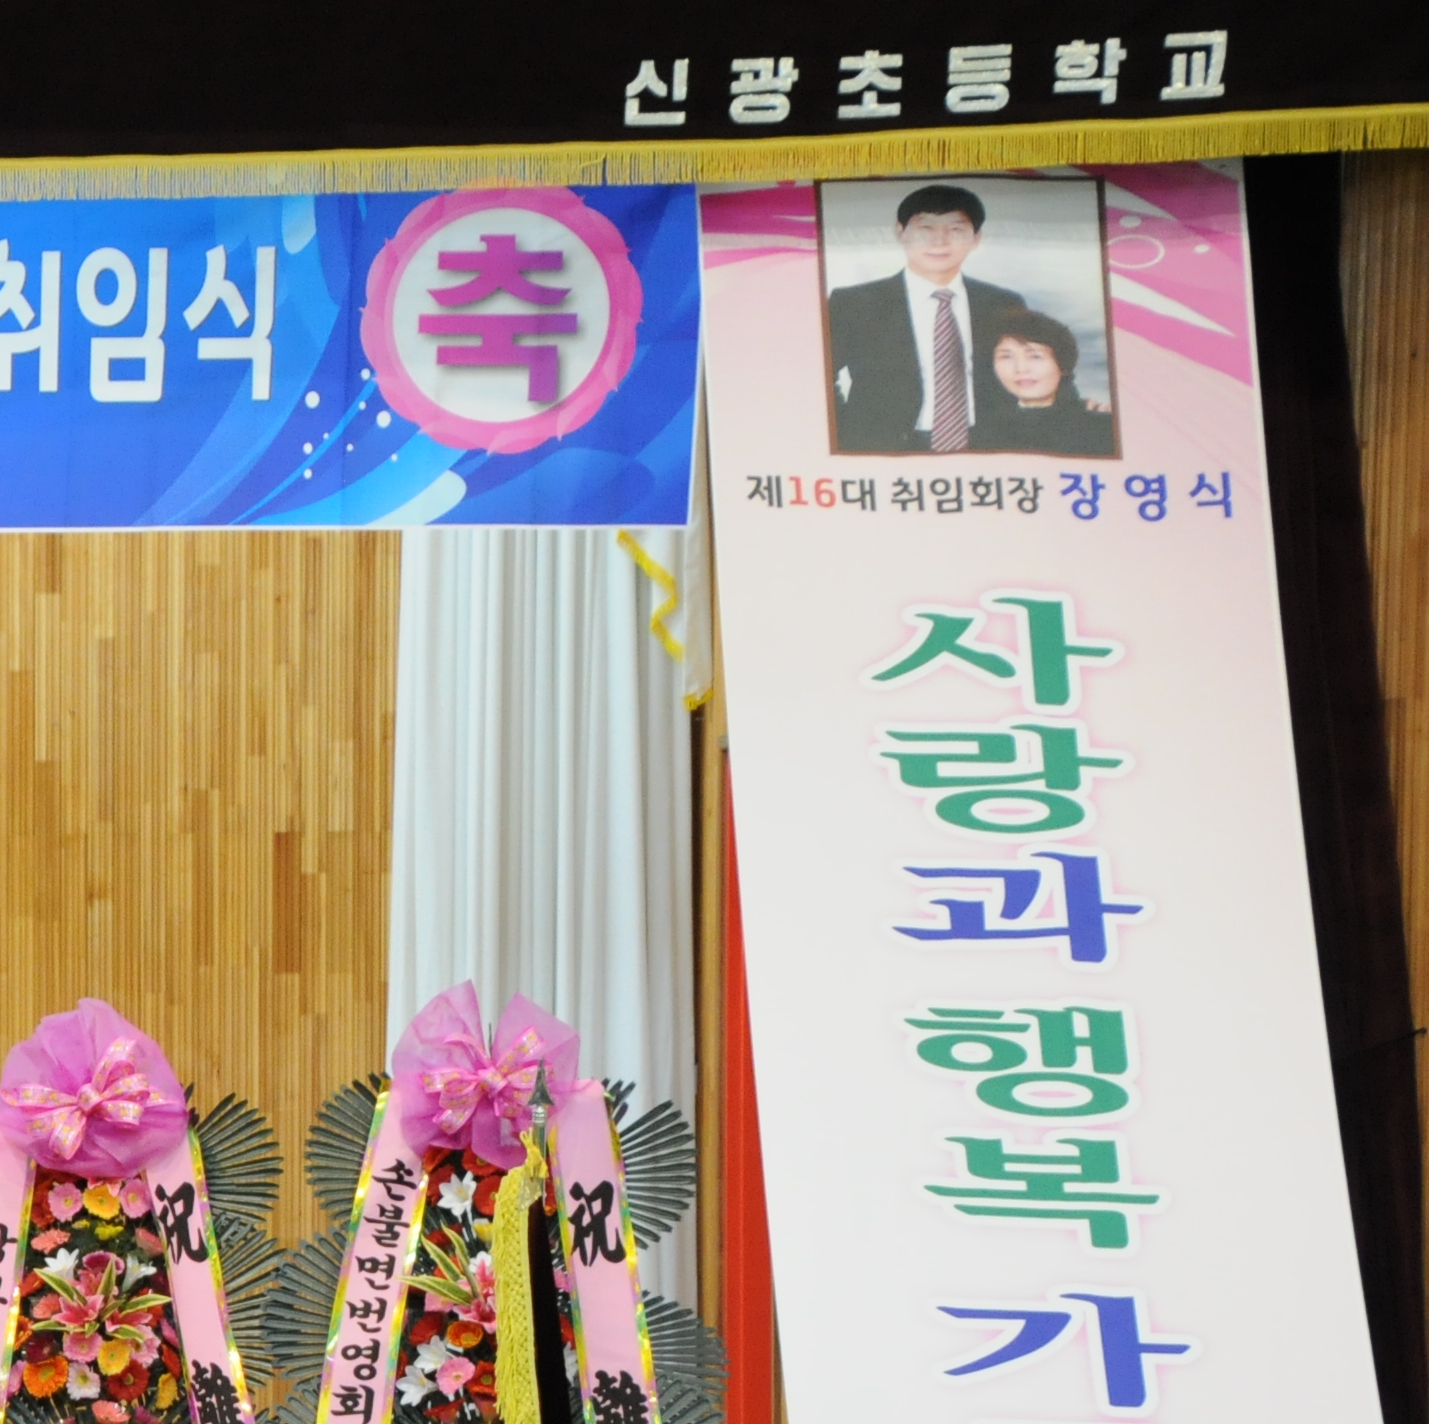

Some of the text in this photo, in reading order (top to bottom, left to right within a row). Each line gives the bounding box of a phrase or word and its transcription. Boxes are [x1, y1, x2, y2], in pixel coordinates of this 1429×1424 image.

[418, 234, 579, 404] 축
[746, 474, 878, 515] 제16대
[890, 475, 1044, 516] 취임회장
[870, 597, 1143, 963] 사랑과
[904, 1005, 1160, 1249] 행복
[155, 1181, 209, 1263] 祝
[569, 1179, 627, 1269] 祝
